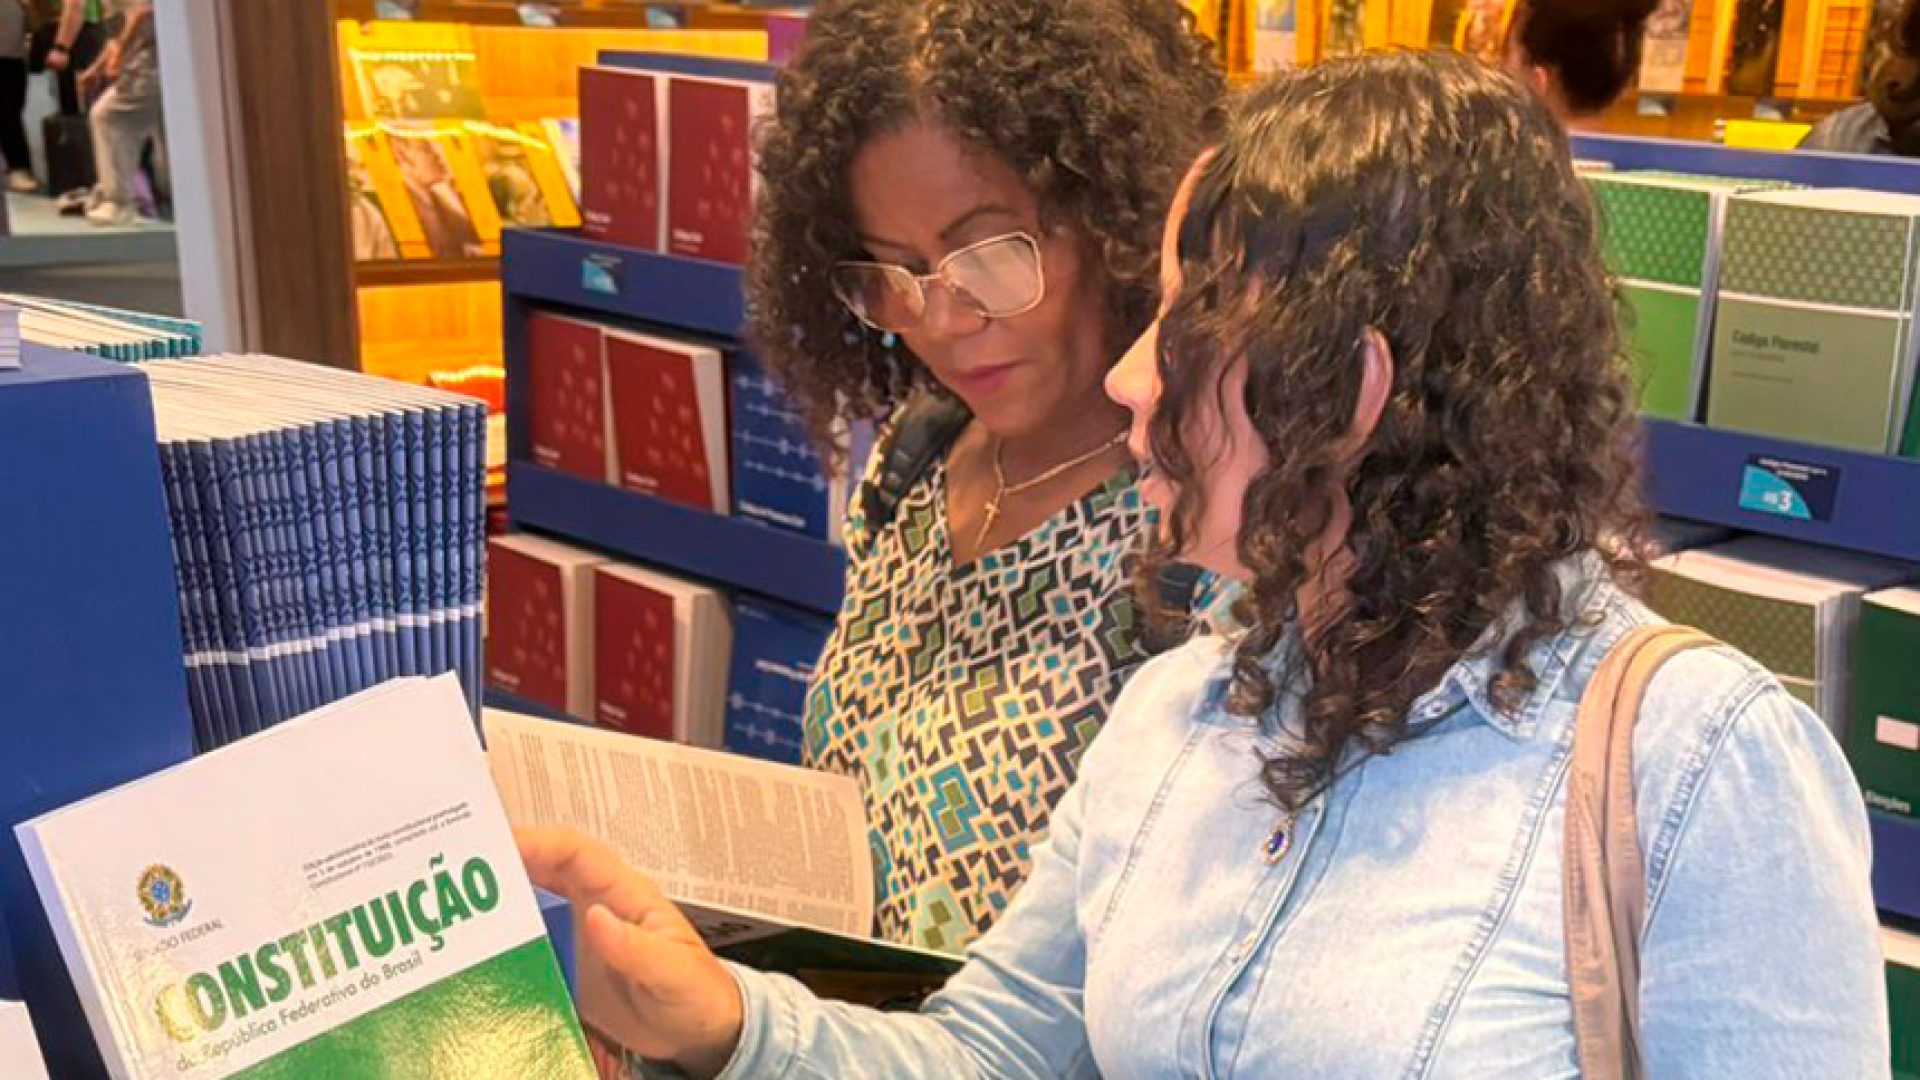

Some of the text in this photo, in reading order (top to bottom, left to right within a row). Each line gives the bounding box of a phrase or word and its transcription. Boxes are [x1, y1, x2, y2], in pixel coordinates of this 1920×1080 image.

[157, 852, 499, 1042] CONSTITUIÇÃO
[279, 981, 358, 1026] Federativa
[359, 971, 380, 990] do
[382, 950, 423, 980] Brasil
